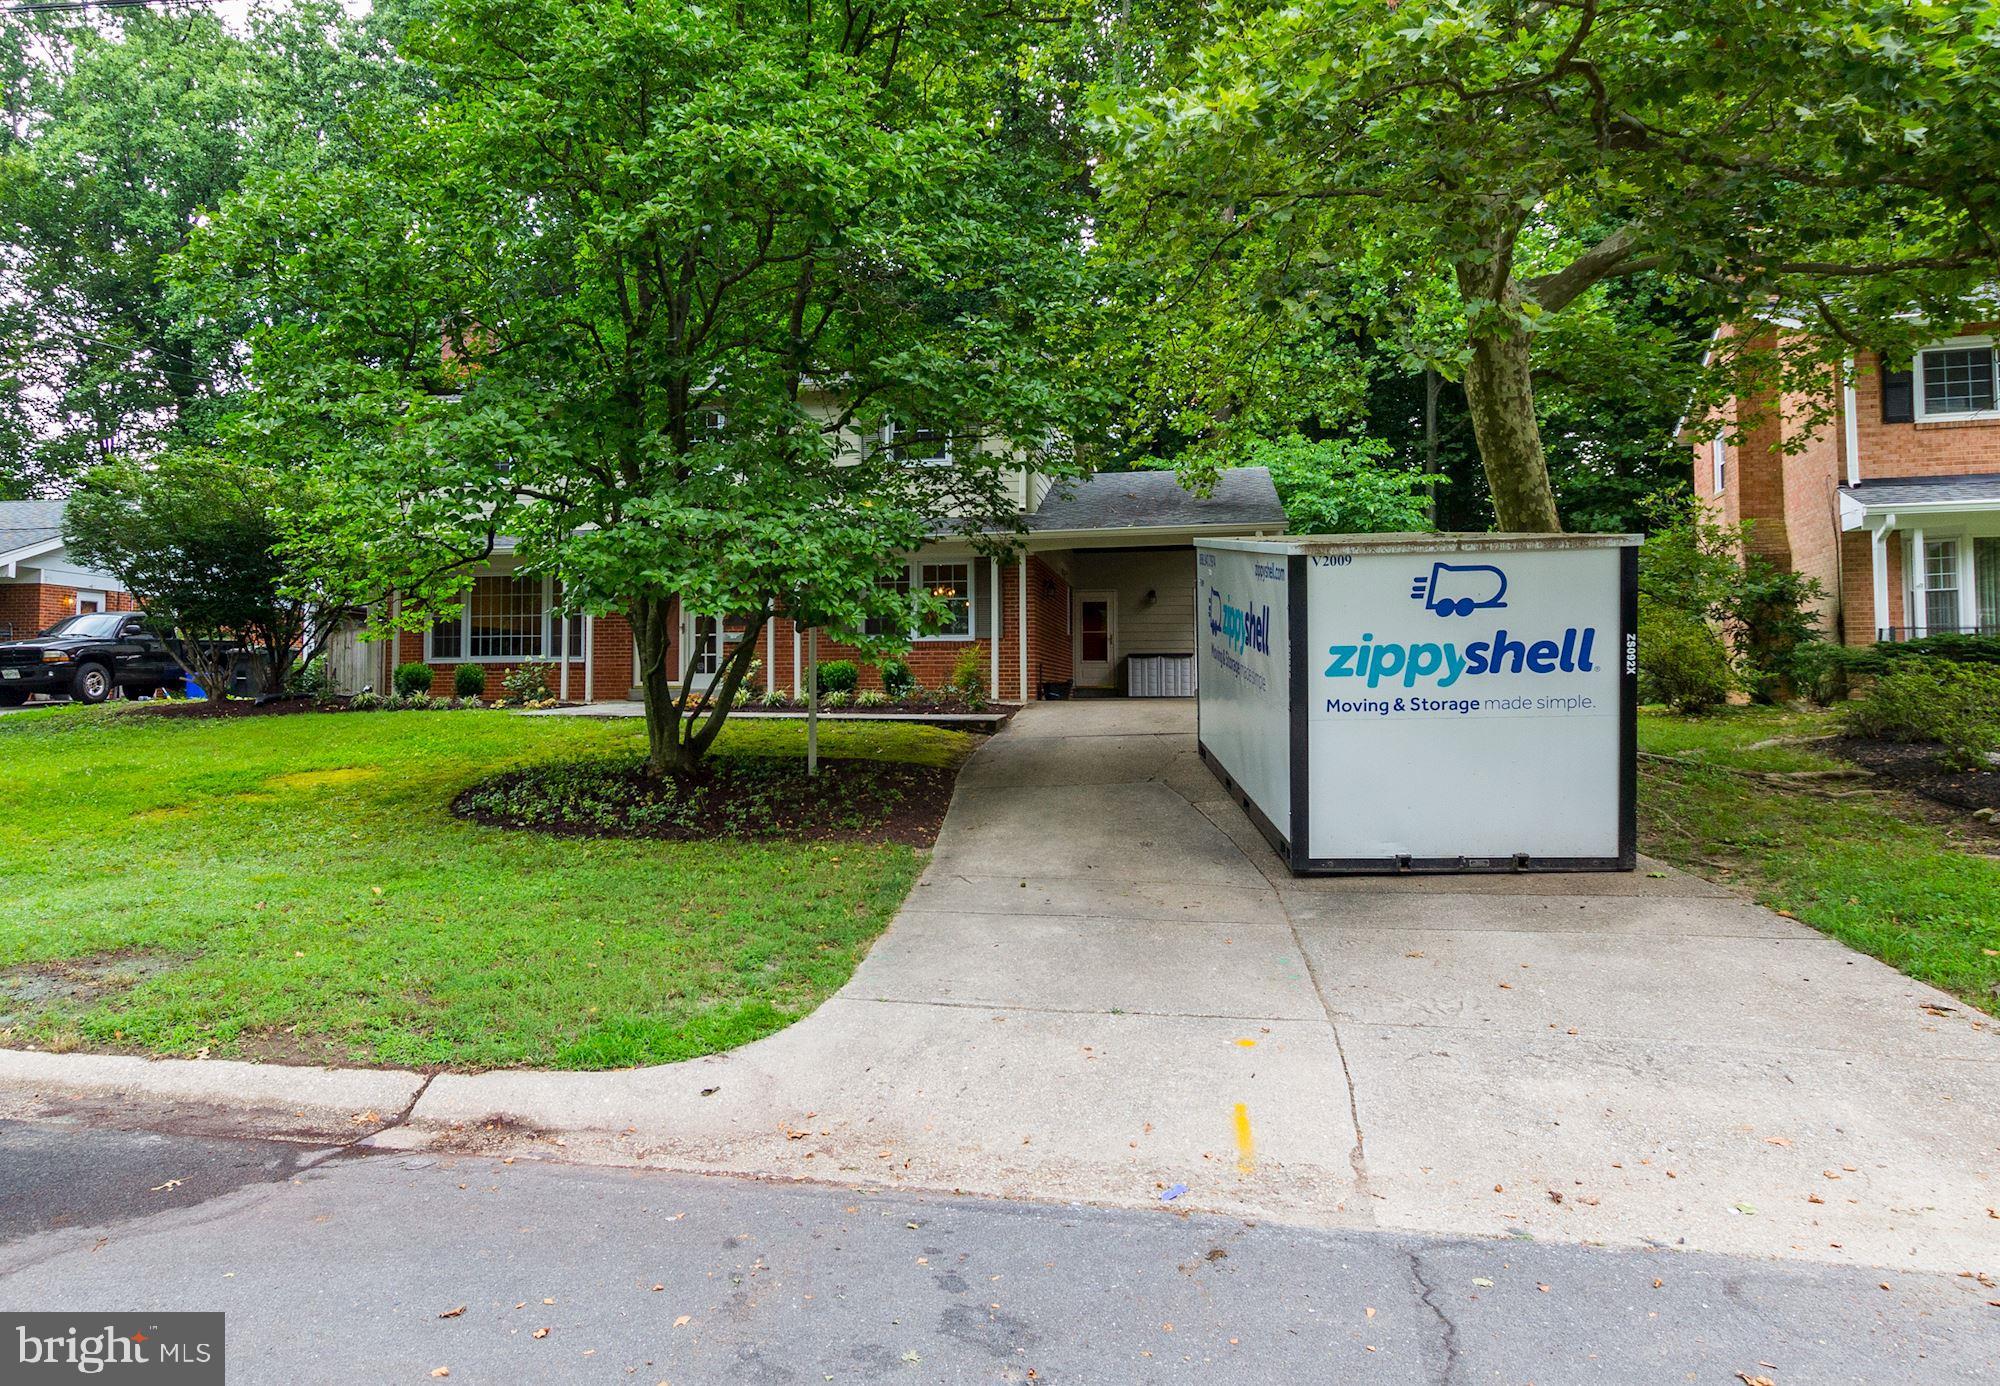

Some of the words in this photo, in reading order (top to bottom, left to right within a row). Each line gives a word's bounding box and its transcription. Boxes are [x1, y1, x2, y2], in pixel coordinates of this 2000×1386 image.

[1312, 554, 1352, 567] V2009
[1222, 594, 1270, 656] zippyshell
[1324, 628, 1596, 688] zippyshell
[1626, 633, 1637, 675] ZS092X
[1326, 698, 1389, 716] Moving
[1393, 698, 1406, 712] &
[1410, 697, 1480, 714] Storage
[1485, 696, 1532, 710] made
[1537, 694, 1596, 712] simple.
